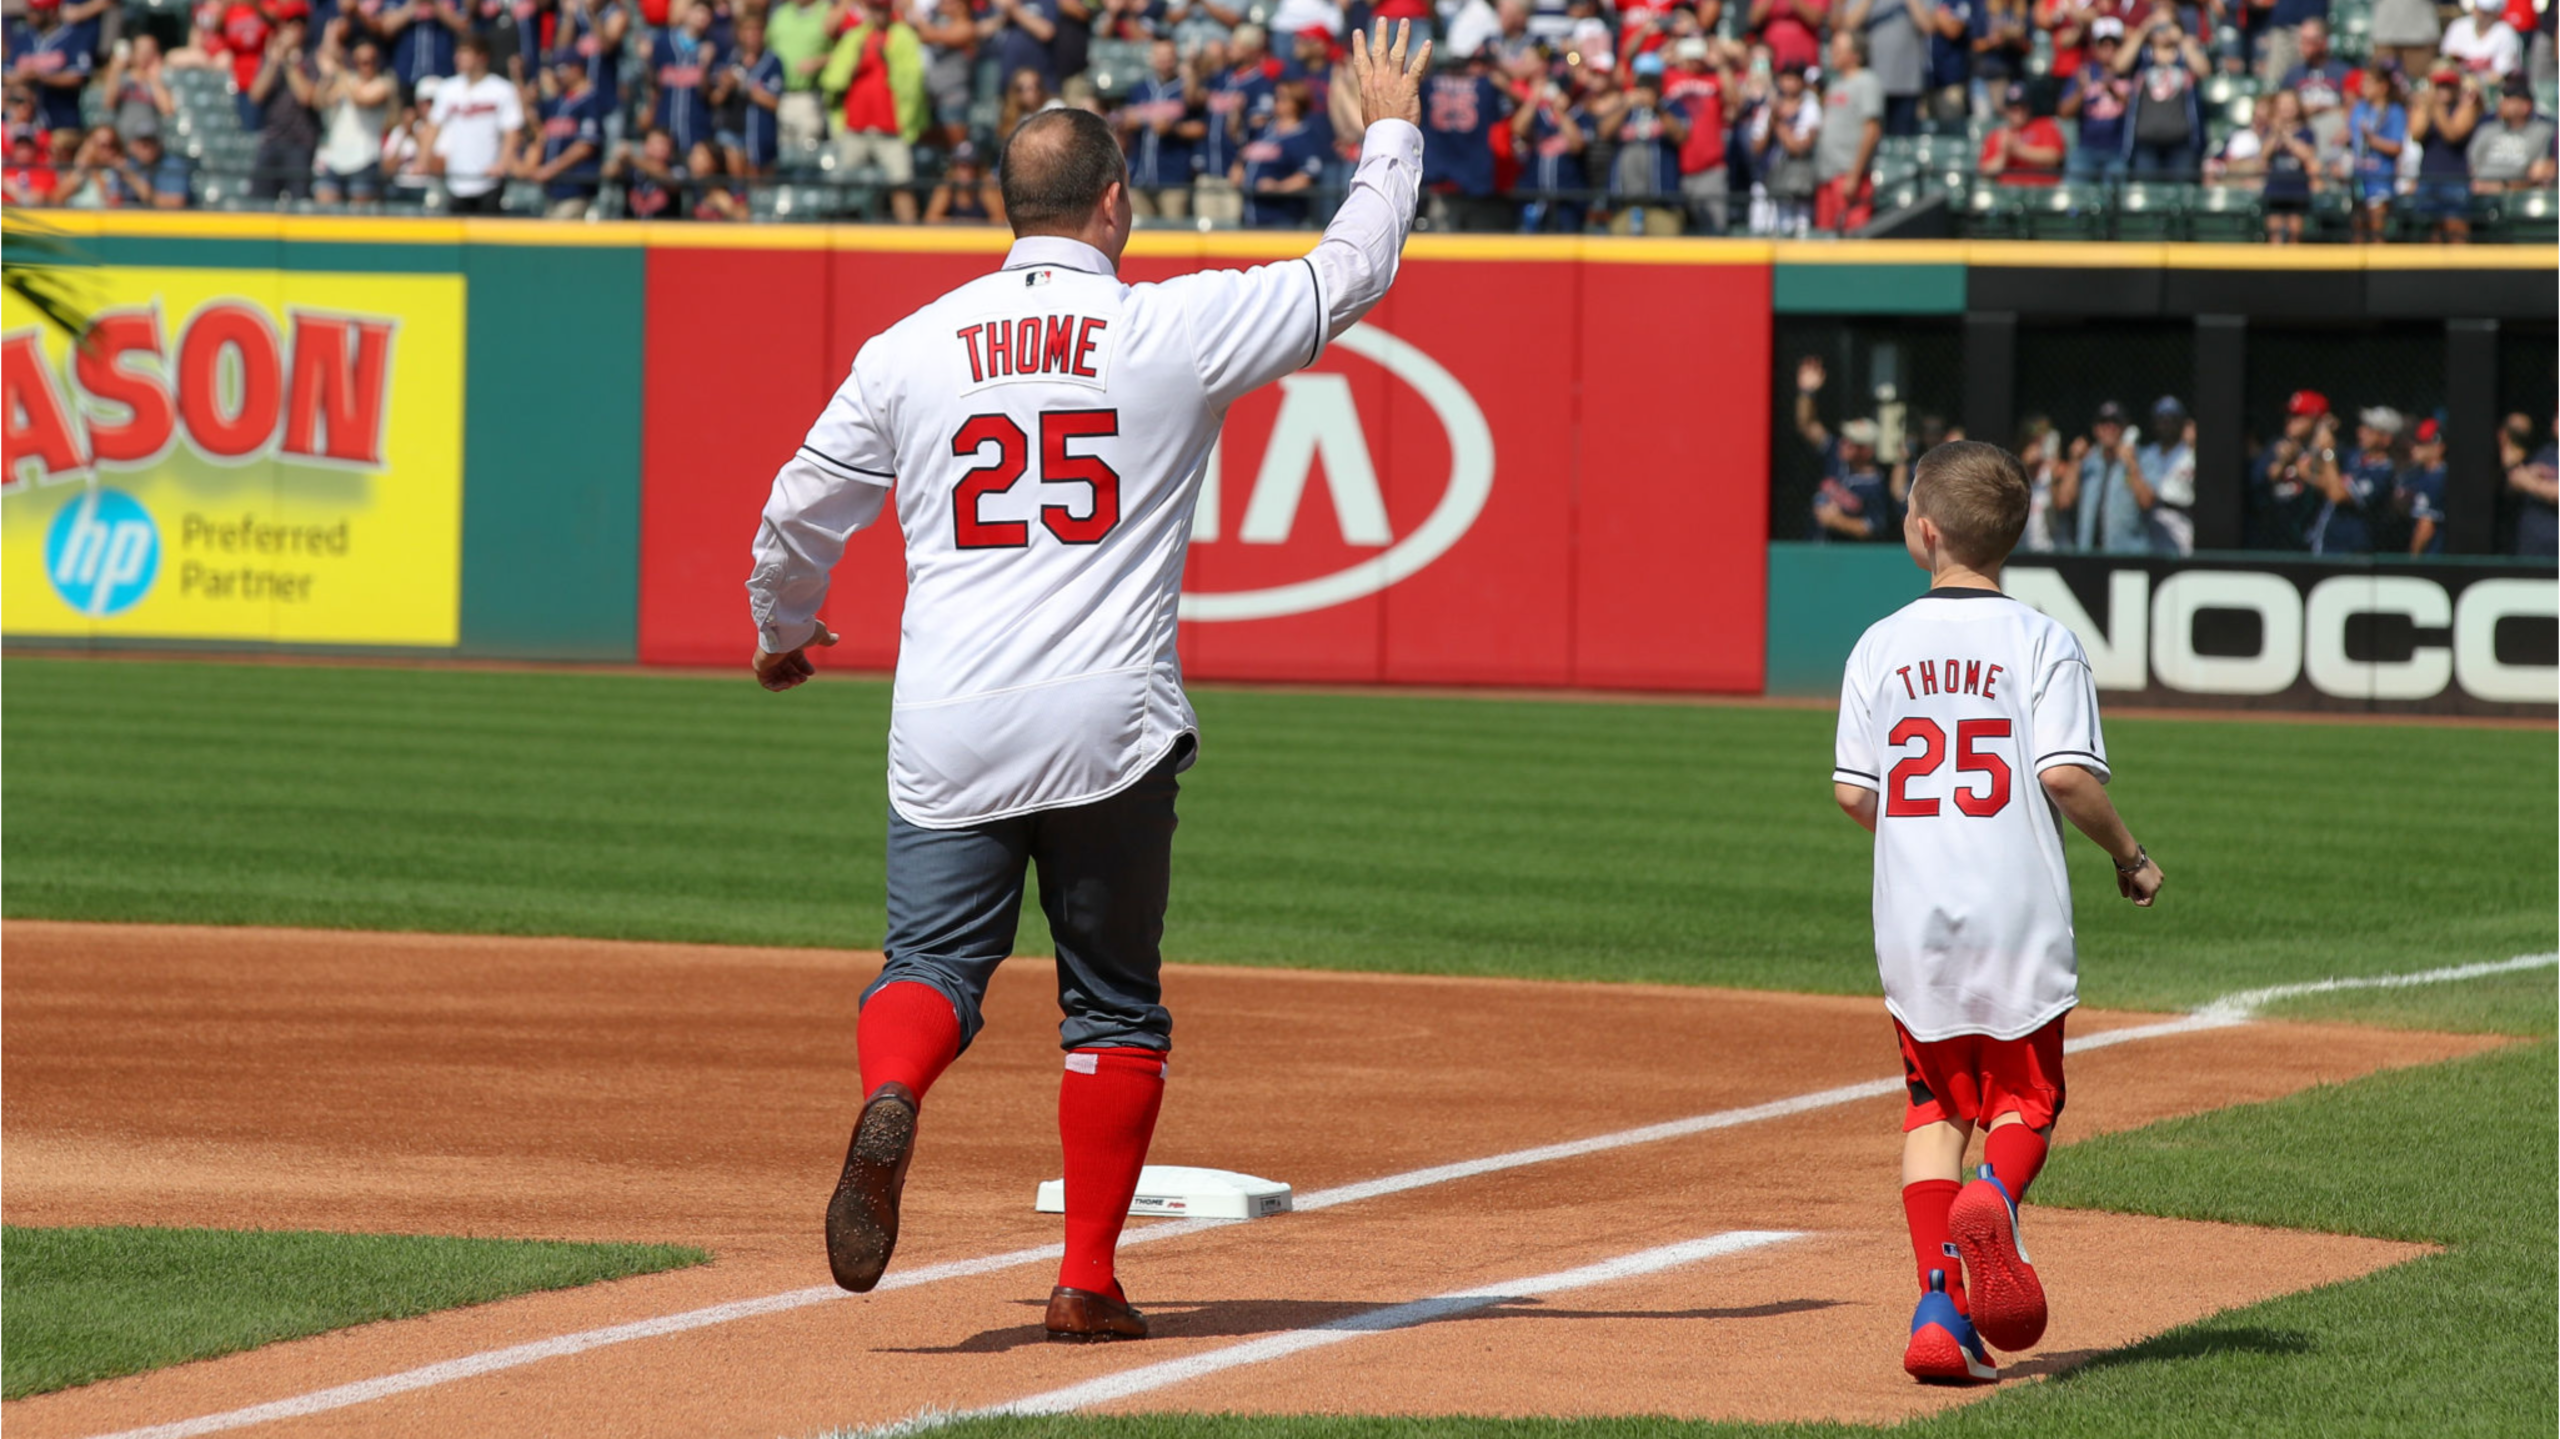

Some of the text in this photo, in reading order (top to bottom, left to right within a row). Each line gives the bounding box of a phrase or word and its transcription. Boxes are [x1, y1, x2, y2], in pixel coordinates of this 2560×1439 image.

[957, 314, 1107, 383] THOME
[951, 408, 1120, 550] 25
[56, 488, 152, 617] hp
[182, 513, 349, 556] Preferred
[180, 560, 314, 602] Partner
[1897, 659, 2004, 700] THOME
[1886, 717, 2012, 817] 25
